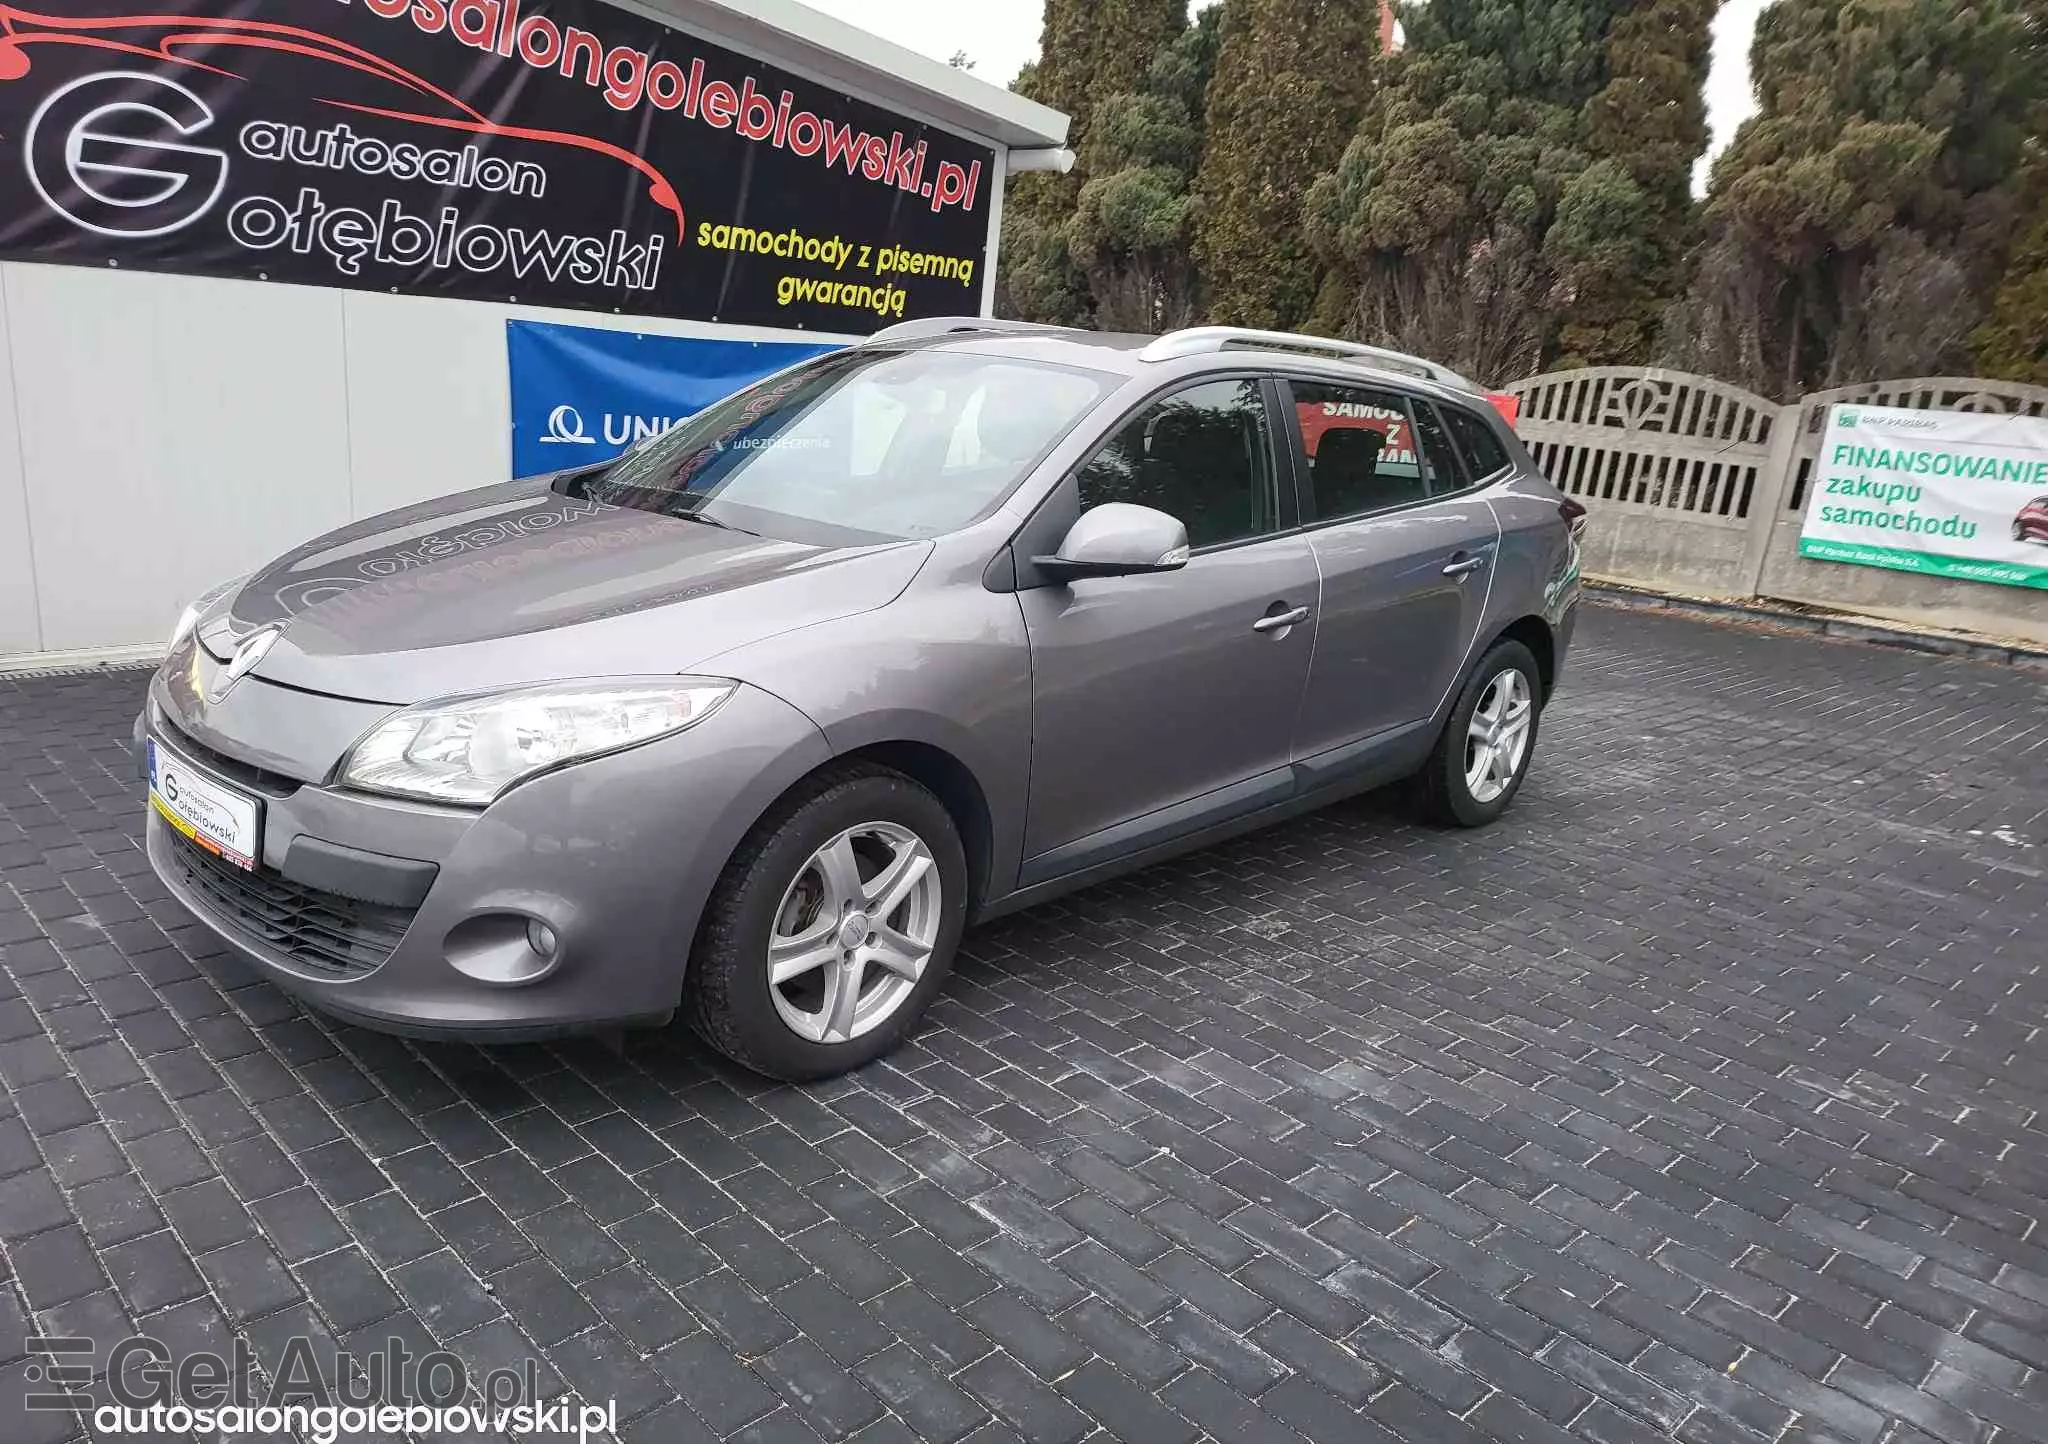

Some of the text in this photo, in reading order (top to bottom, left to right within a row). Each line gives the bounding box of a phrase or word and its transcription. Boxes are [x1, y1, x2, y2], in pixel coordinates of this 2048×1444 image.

[239, 120, 547, 197] autosalon
[698, 222, 973, 287] samochody z pisemną
[777, 274, 906, 317] gwarancją
[603, 413, 689, 445] UNI
[1386, 423, 1400, 444] Z
[1834, 445, 2048, 484] FINANSOWANIE
[1826, 475, 1922, 505] zakupu
[1820, 505, 1978, 538] samochodu
